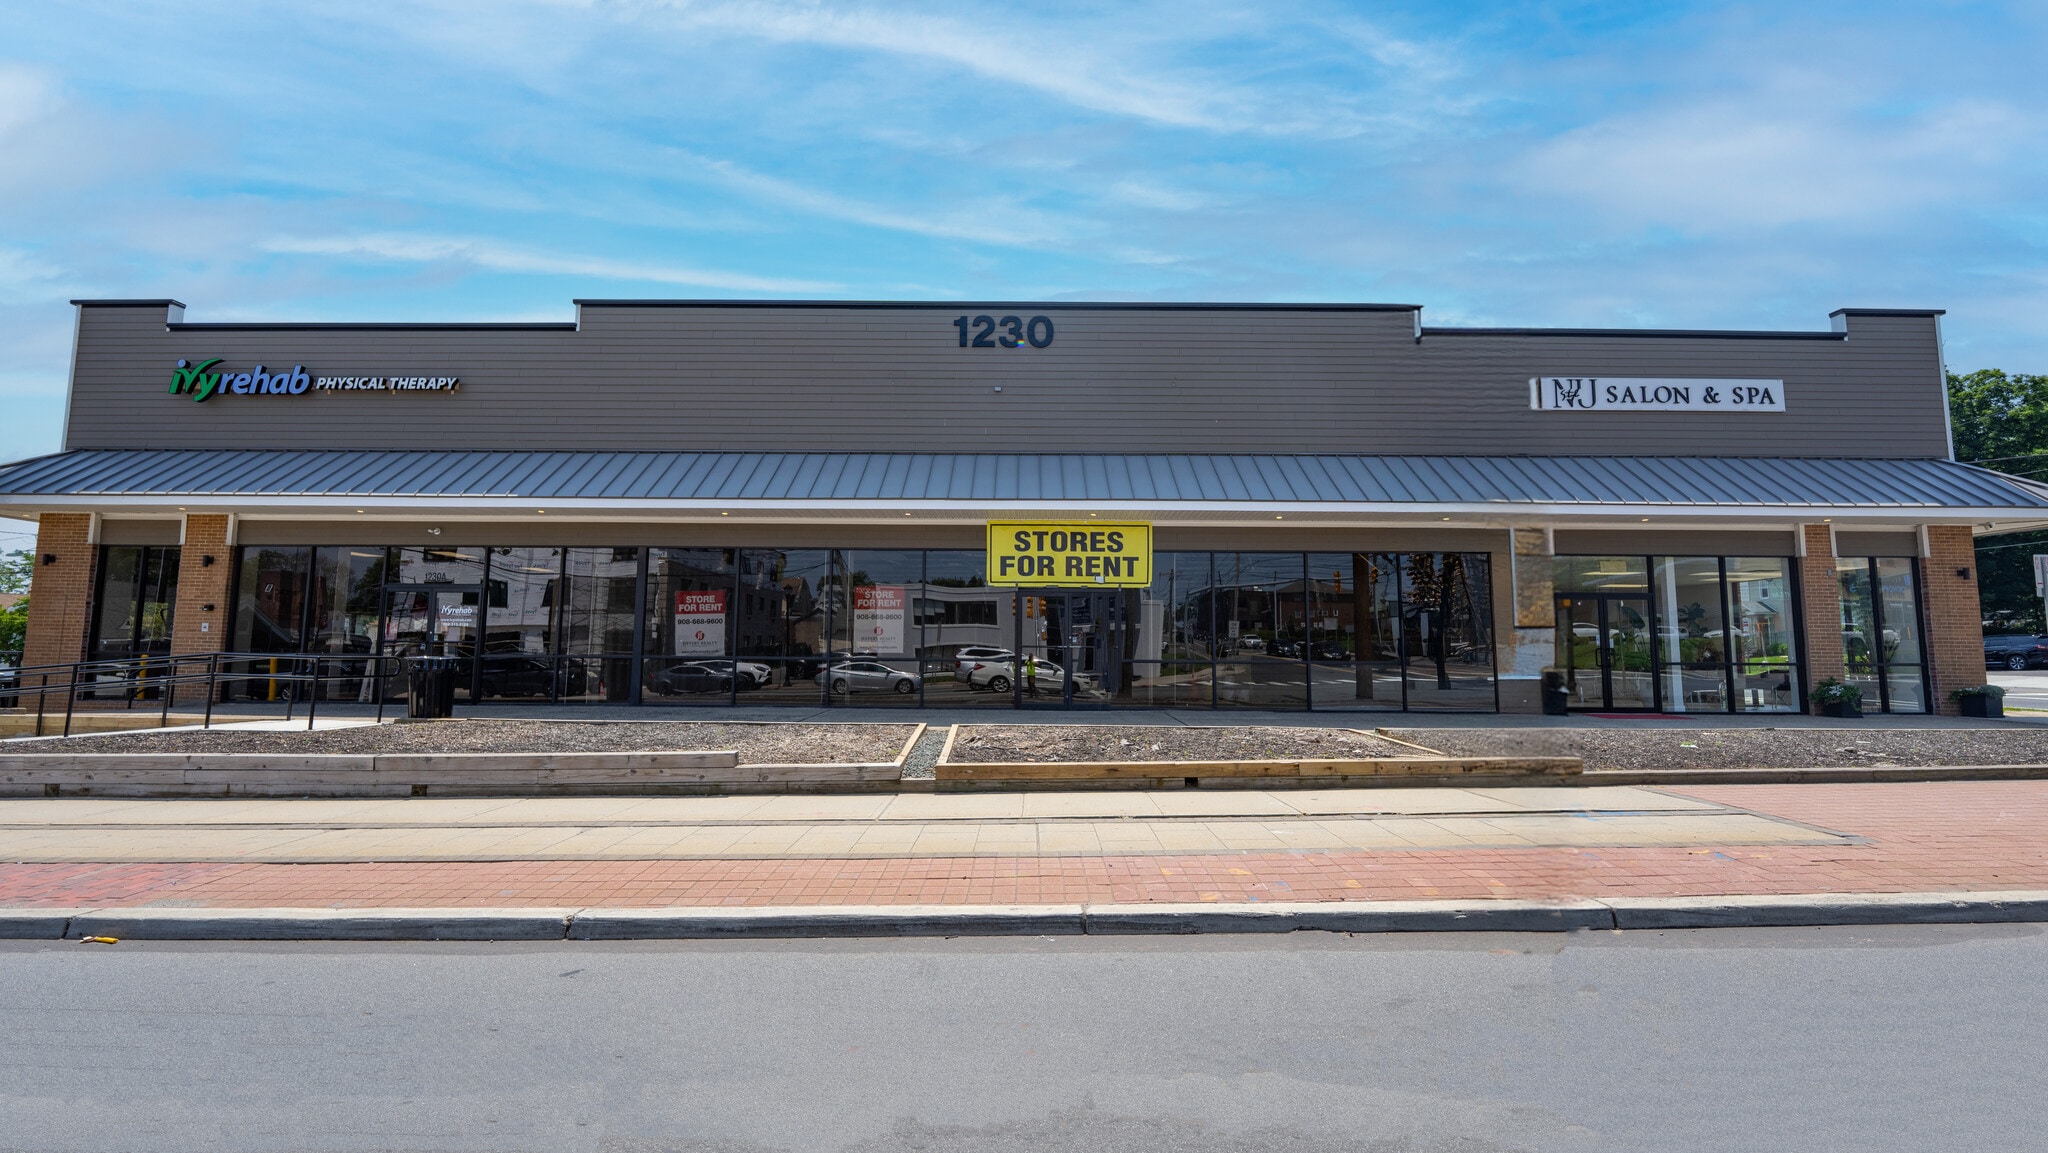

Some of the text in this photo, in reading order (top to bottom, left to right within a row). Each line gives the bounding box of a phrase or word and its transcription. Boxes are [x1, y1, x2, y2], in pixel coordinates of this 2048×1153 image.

[953, 315, 1054, 349] 1230
[315, 376, 388, 391] PHYSICAL
[390, 376, 457, 390] THERAPY
[1606, 385, 1690, 405] SALON
[1703, 386, 1722, 404] &
[1732, 386, 1776, 405] SPA
[1014, 531, 1124, 553] STORES
[1000, 555, 1139, 577] FOR RENT
[425, 572, 447, 581] 1230A
[686, 595, 715, 603] STORE
[857, 599, 902, 607] FOR RENT
[678, 603, 723, 612] FOR RENT
